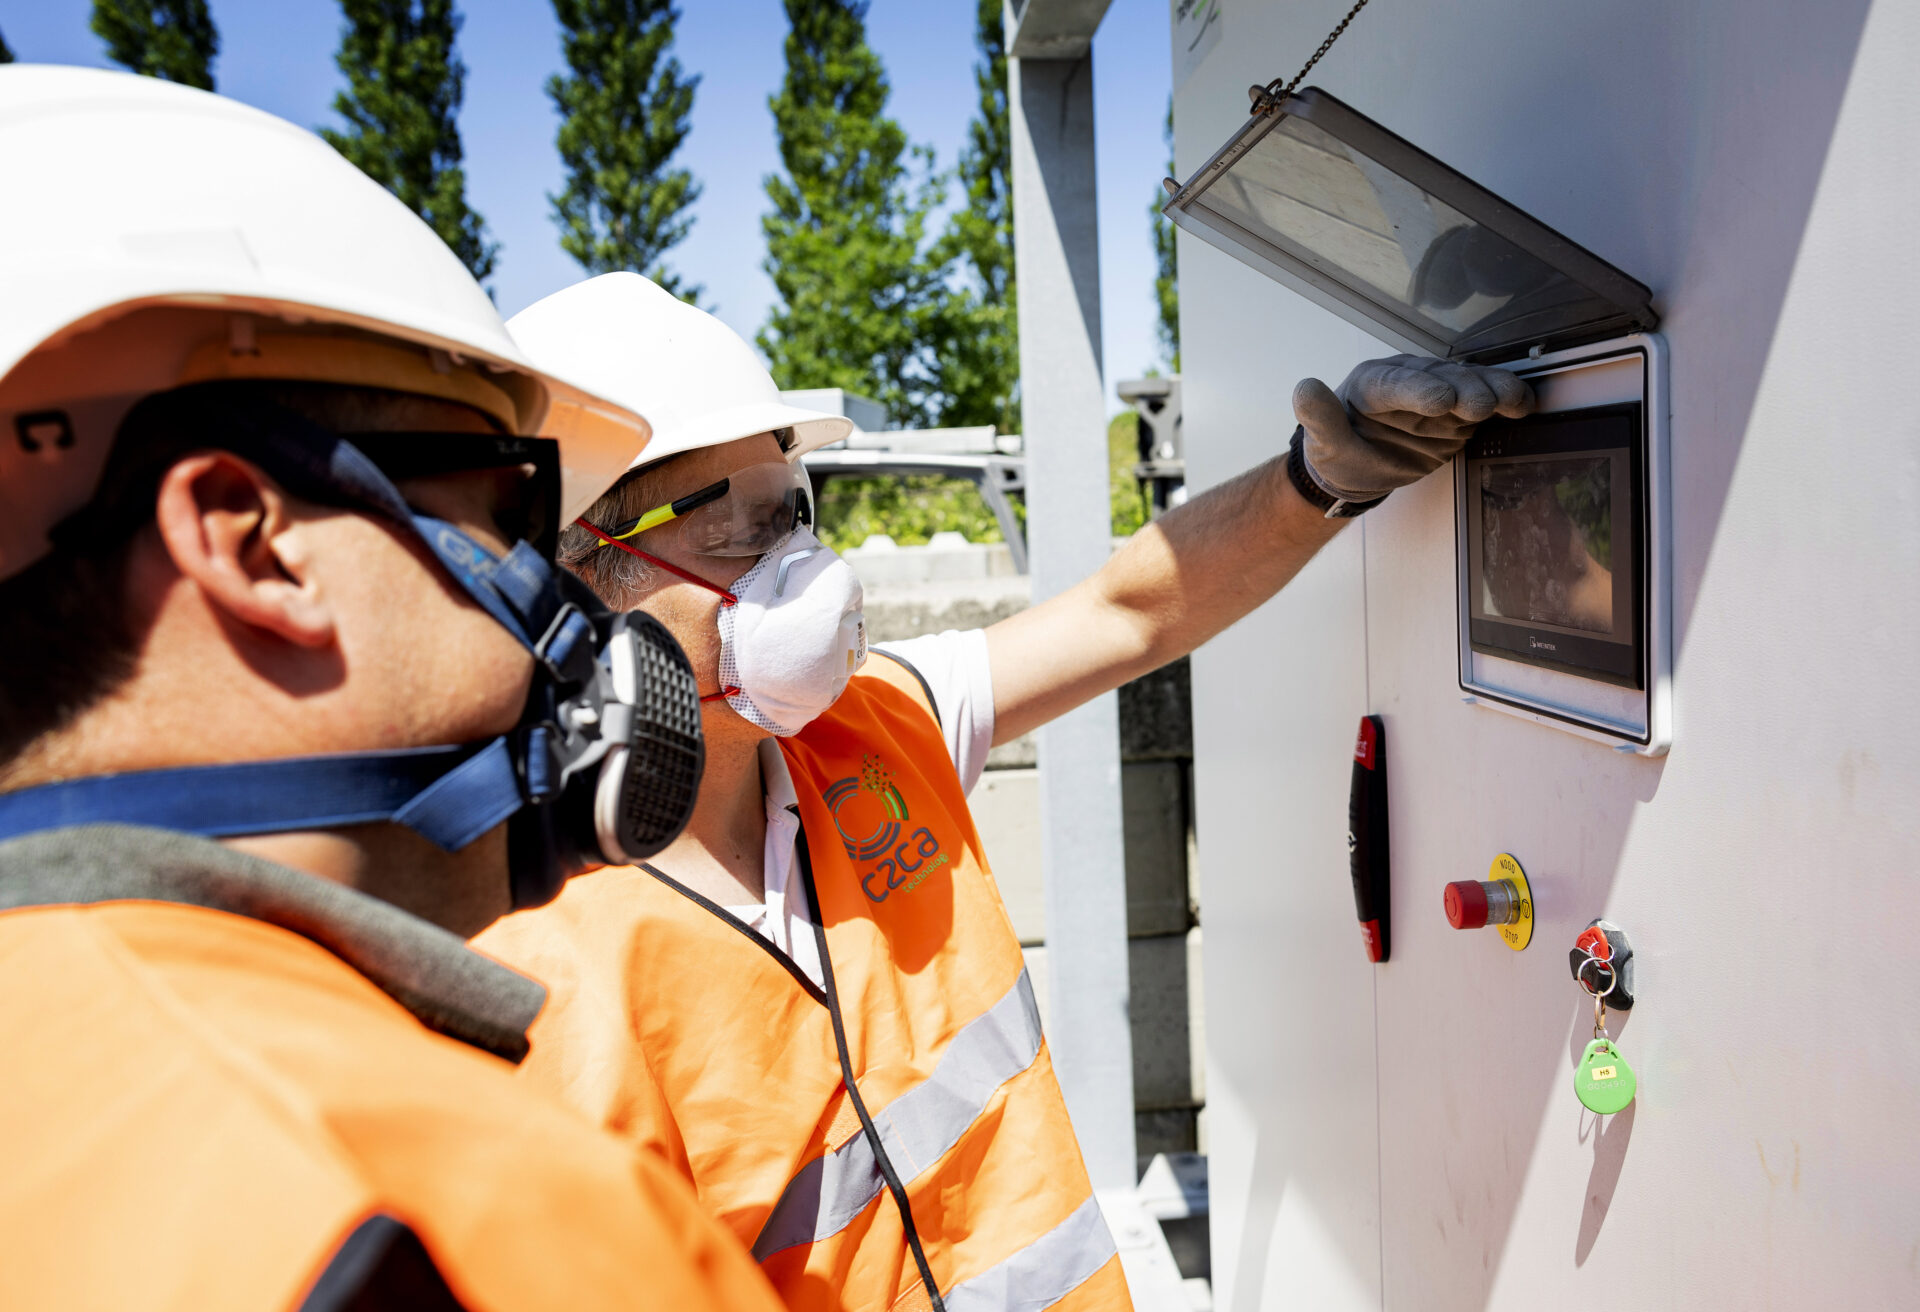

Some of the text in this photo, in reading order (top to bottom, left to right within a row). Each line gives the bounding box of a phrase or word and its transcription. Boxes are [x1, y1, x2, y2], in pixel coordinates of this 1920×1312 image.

[1500, 859, 1516, 874] NOOD
[1504, 929, 1519, 944] STOP
[1599, 1068, 1610, 1077] H5
